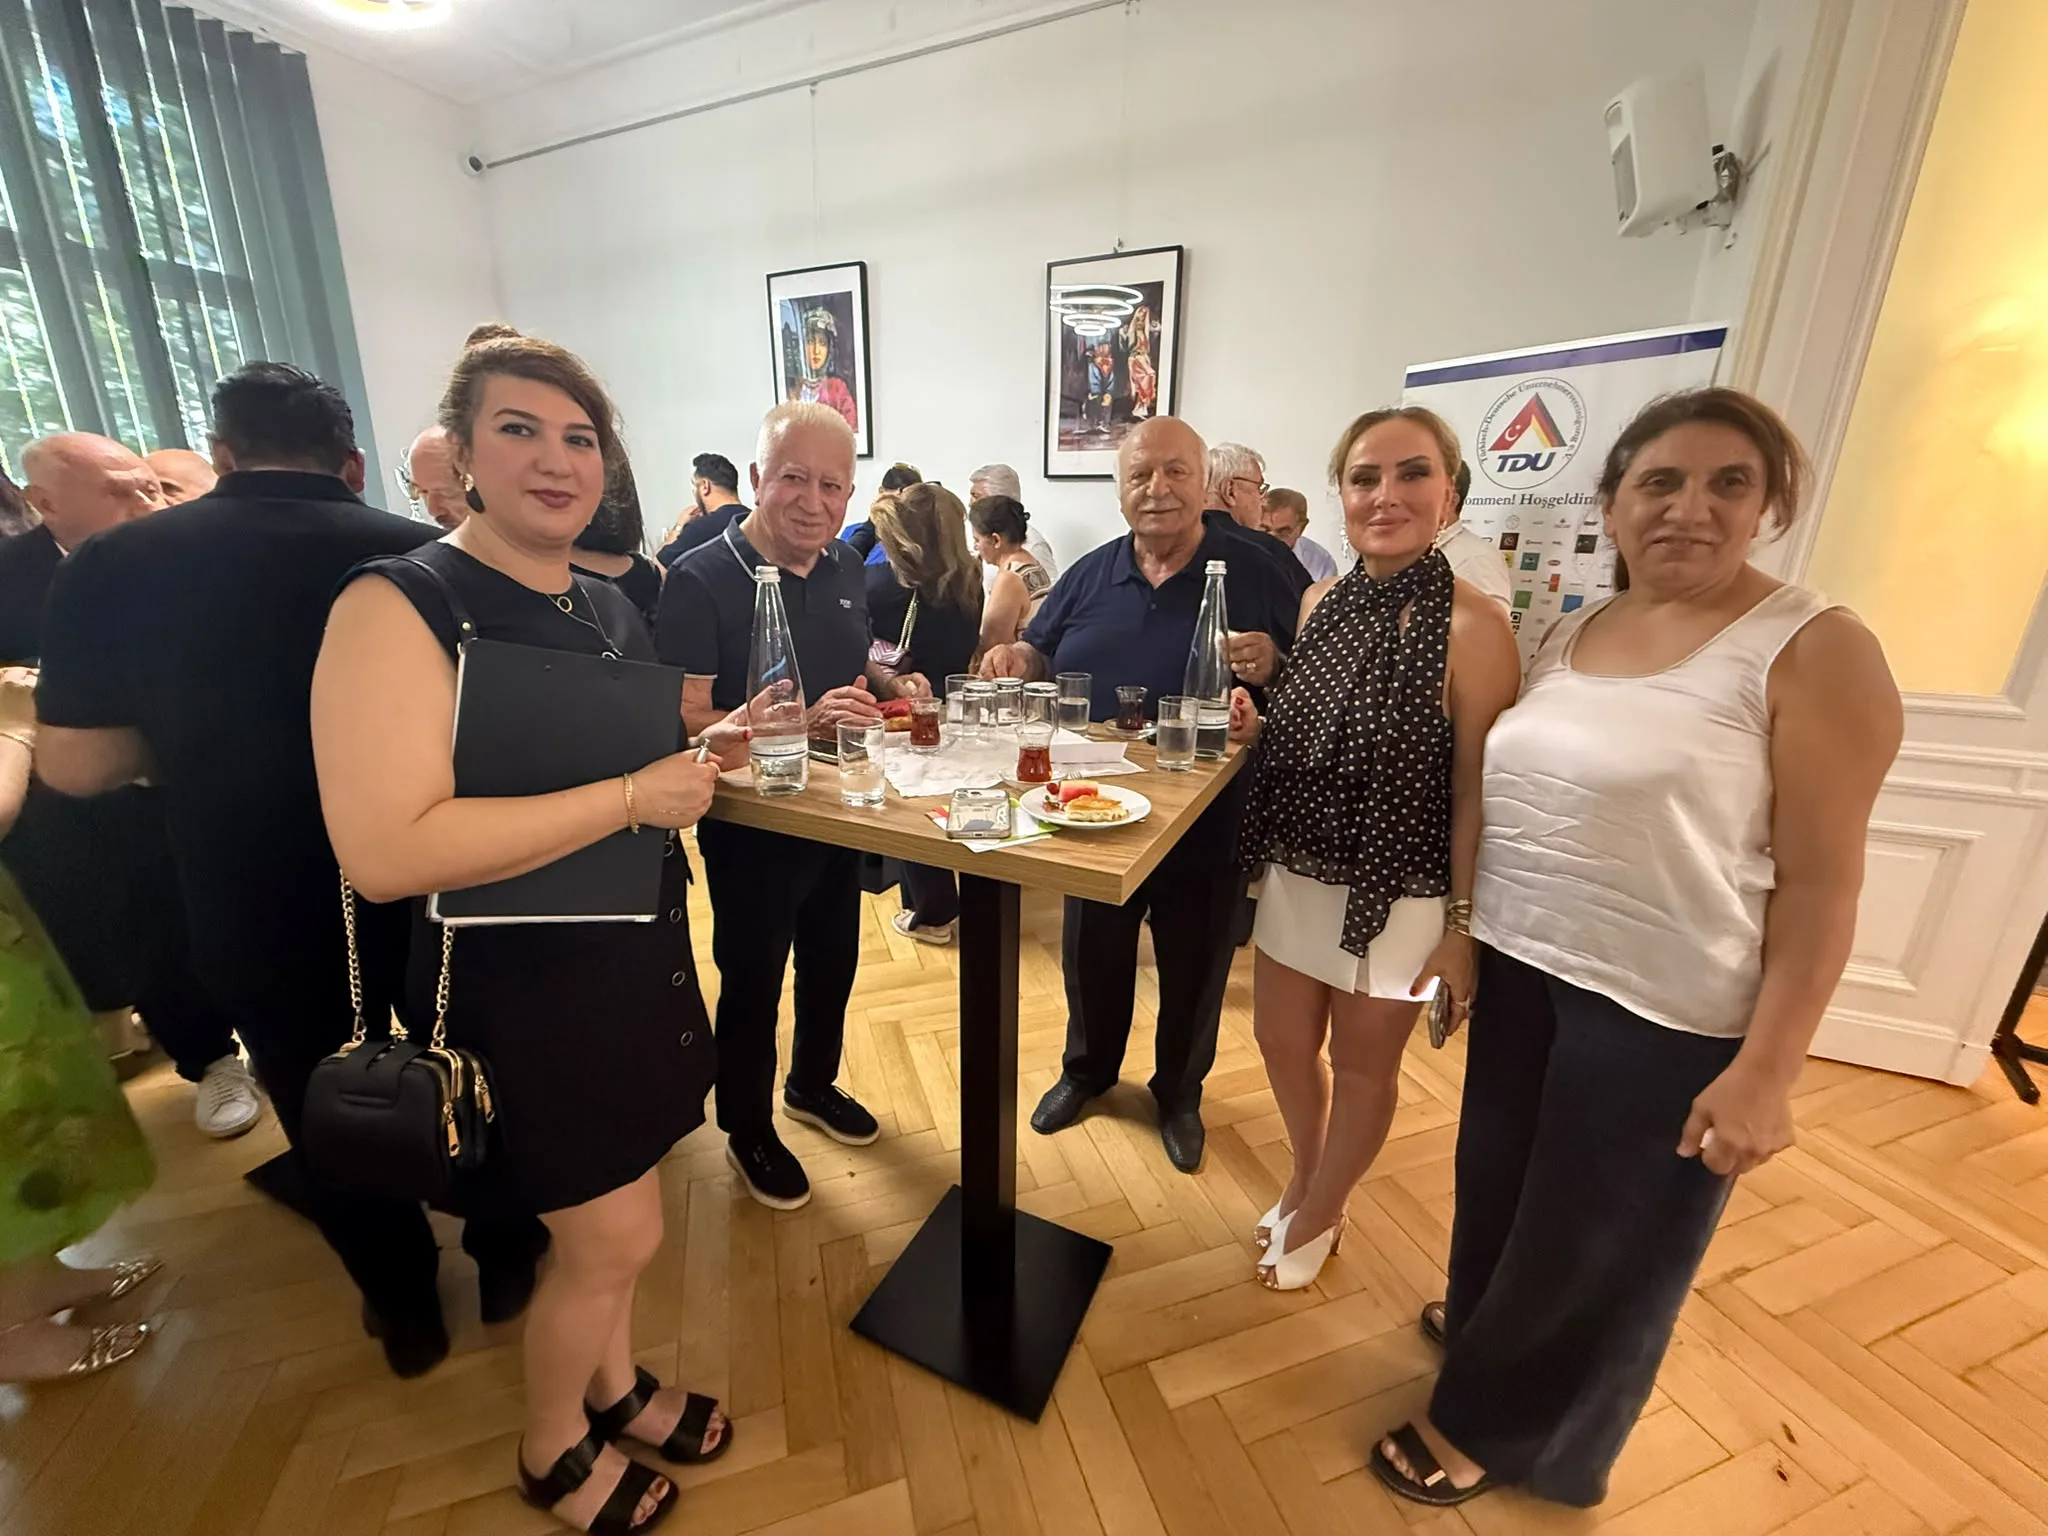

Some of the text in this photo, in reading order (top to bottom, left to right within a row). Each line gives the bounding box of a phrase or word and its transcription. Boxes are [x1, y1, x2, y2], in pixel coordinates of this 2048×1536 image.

[1496, 452, 1557, 473] TDU
[1464, 492, 1598, 509] ommen! Hoşgeldin
